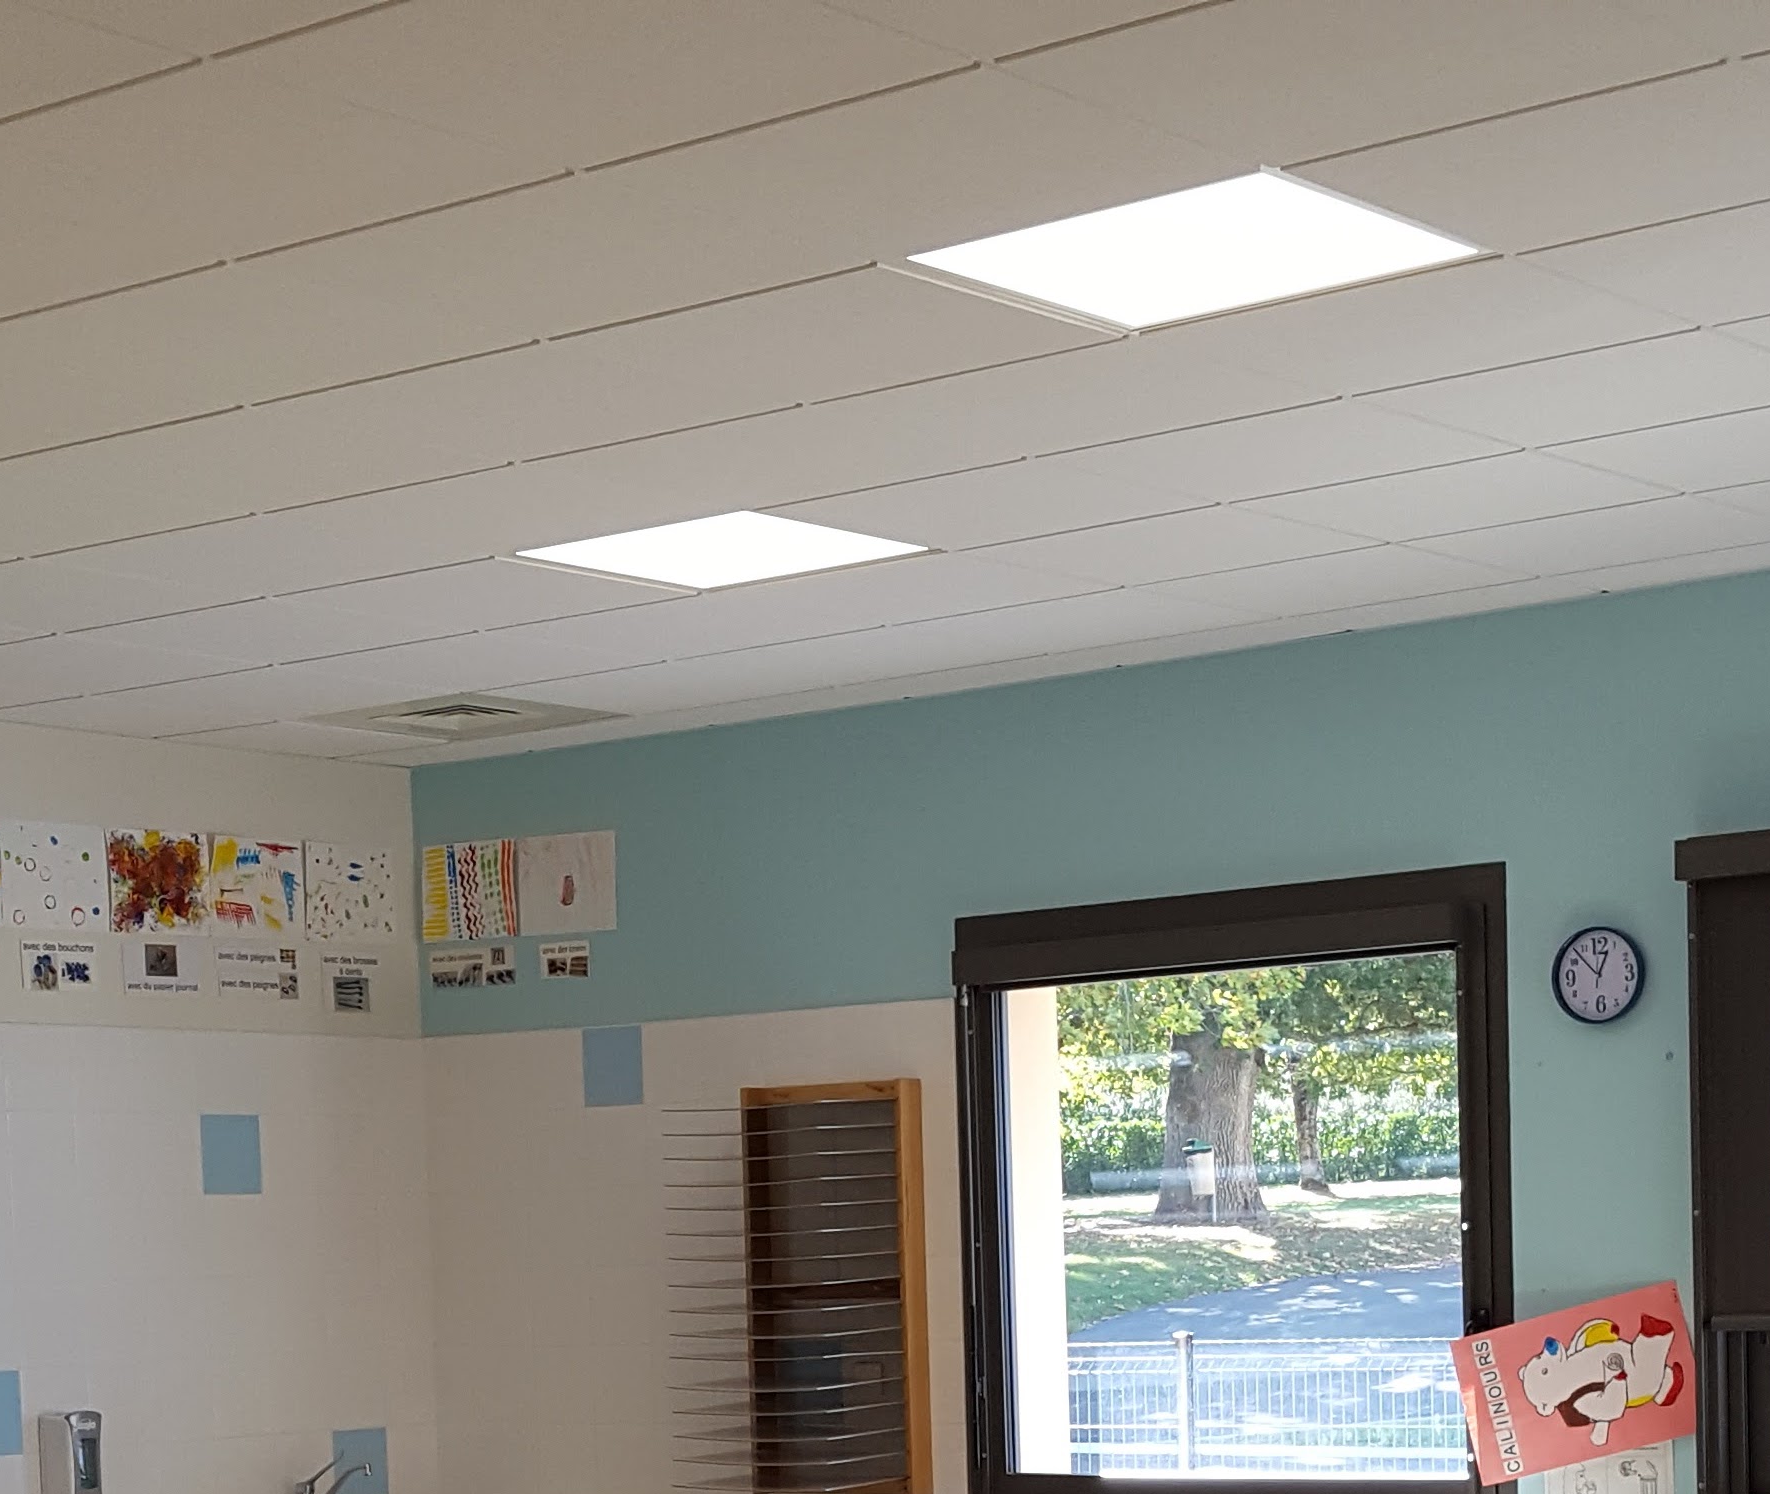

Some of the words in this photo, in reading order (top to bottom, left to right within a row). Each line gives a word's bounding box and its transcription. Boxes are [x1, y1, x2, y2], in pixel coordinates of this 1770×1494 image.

[22, 942, 41, 951] avec
[42, 942, 57, 951] des
[58, 942, 94, 953] bouchons
[1591, 936, 1608, 955] 12
[1565, 969, 1576, 987] 9
[1624, 963, 1635, 981] 3
[1595, 994, 1606, 1013] 6
[1475, 1341, 1521, 1473] CALINOURS
